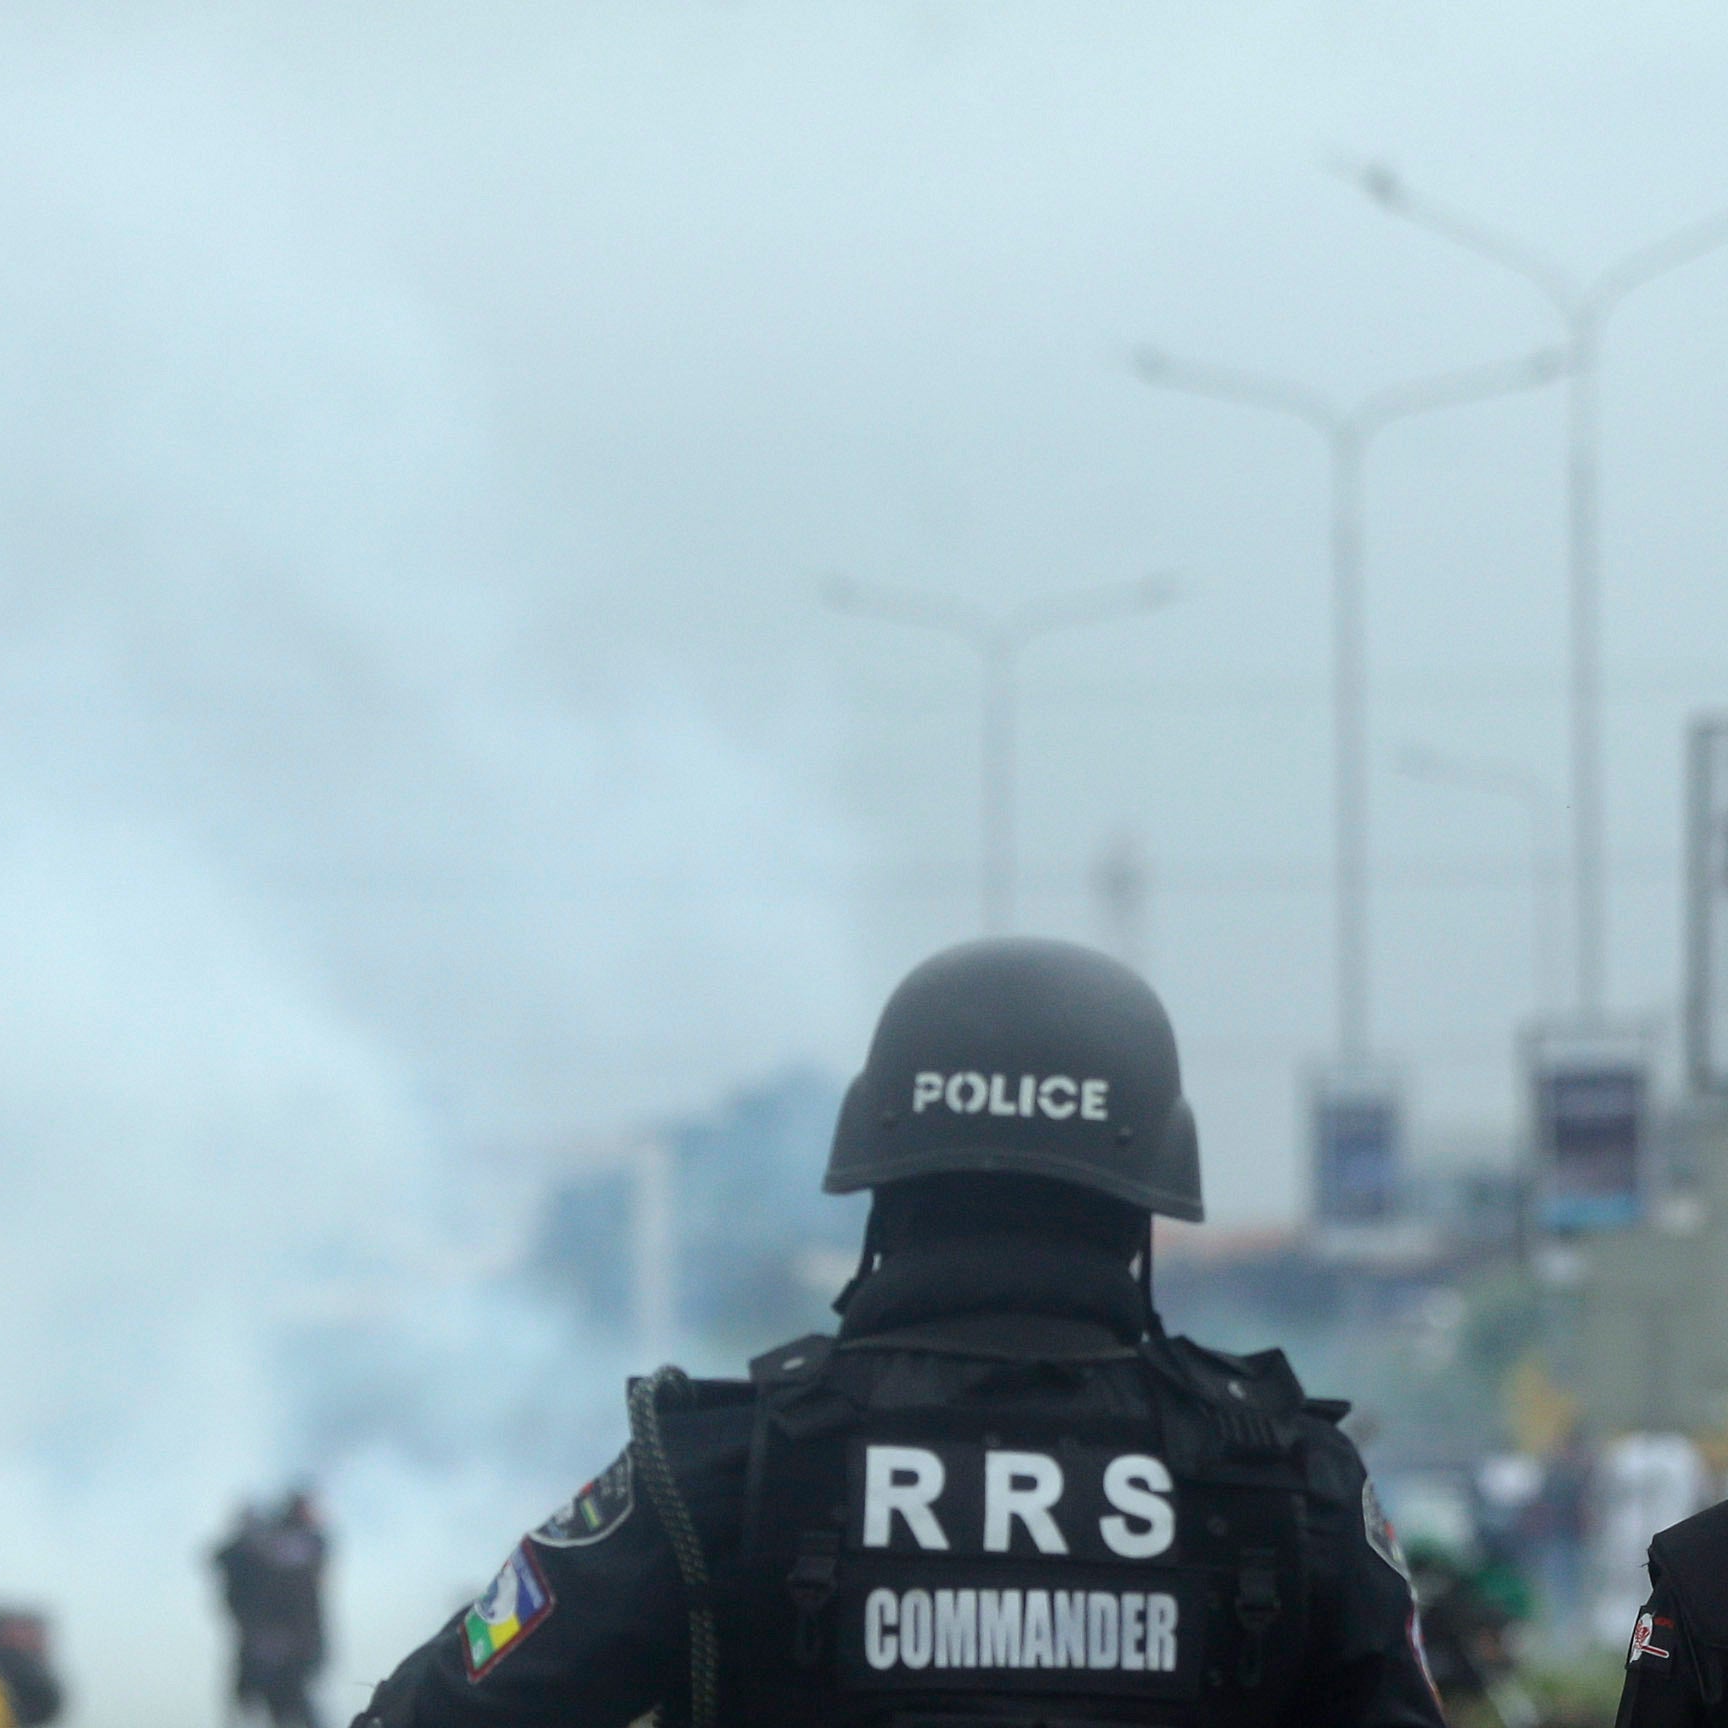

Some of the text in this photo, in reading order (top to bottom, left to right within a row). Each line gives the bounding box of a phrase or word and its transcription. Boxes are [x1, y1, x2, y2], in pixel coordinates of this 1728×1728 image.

[912, 1070, 1110, 1121] POLICE
[862, 1444, 1176, 1559] RRS
[864, 1587, 1179, 1672] COMMANDER
